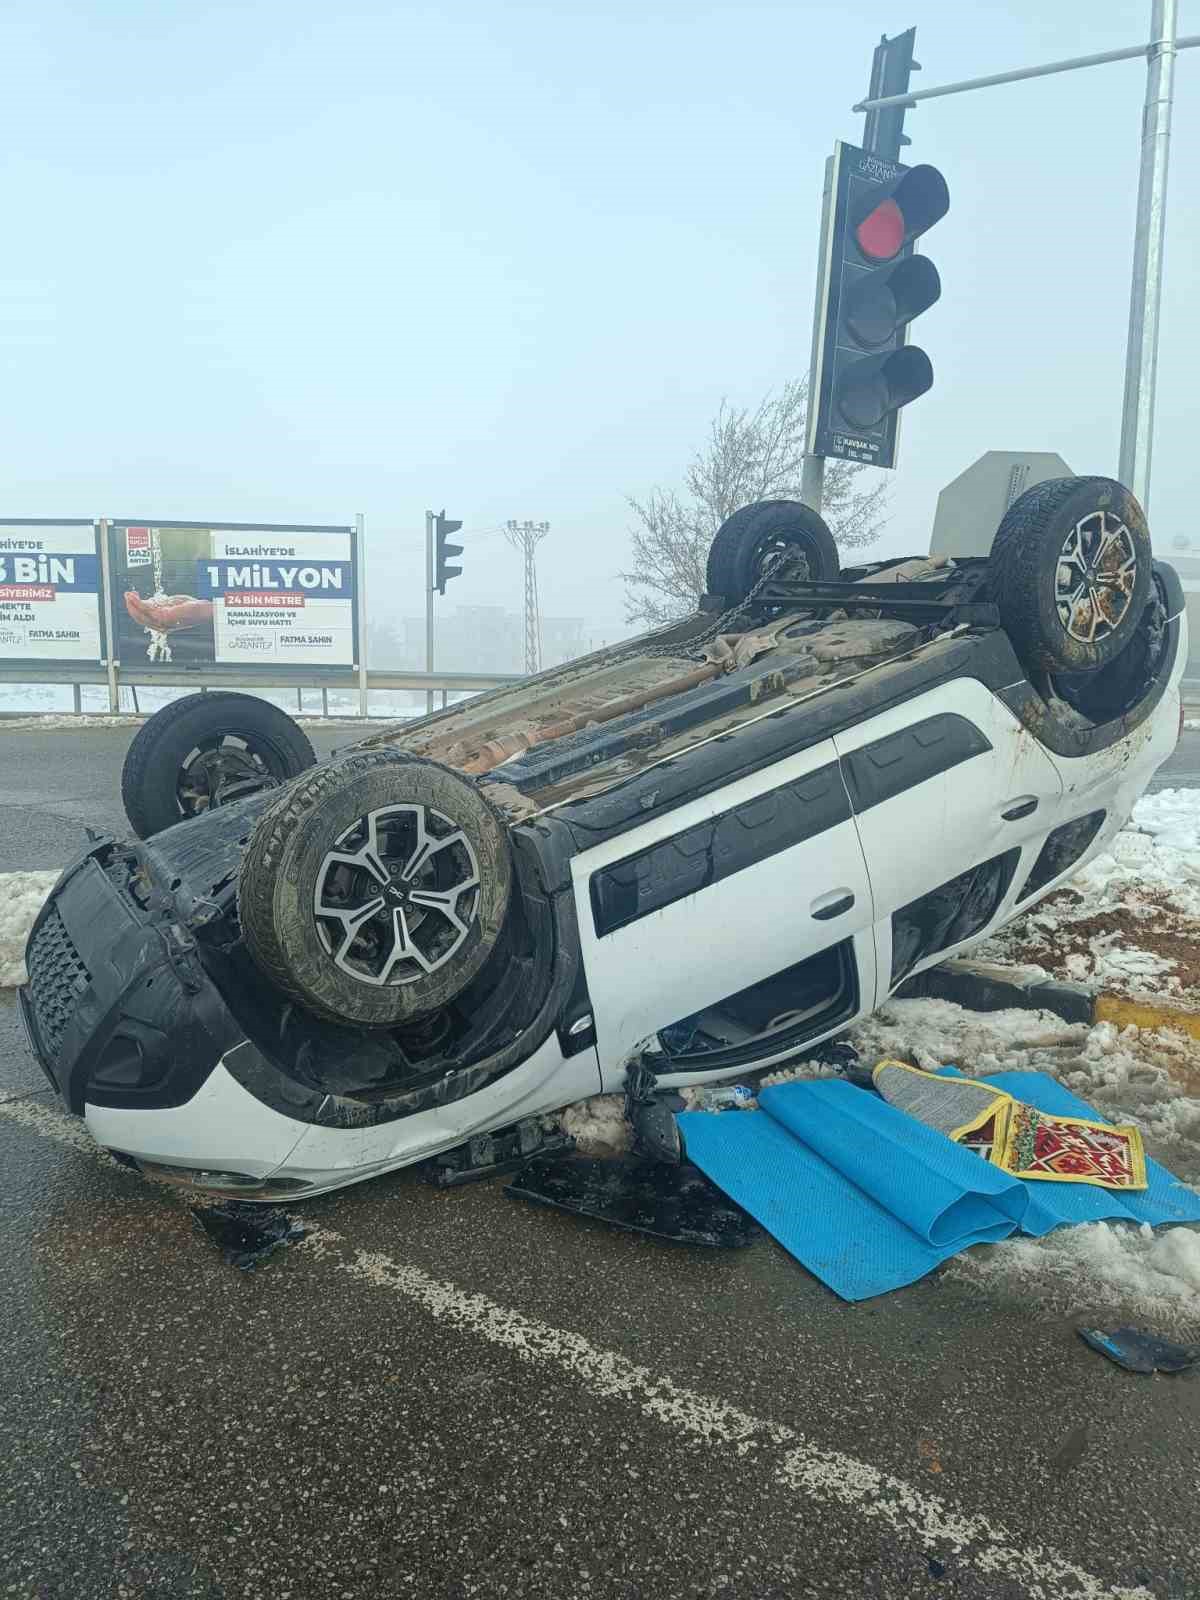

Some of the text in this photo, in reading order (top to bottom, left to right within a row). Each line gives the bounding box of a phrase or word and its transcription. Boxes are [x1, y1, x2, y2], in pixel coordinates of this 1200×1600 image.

[225, 545, 296, 556] İSLAHİYE'DE
[14, 554, 75, 584] BİN
[208, 564, 342, 589] 1 MİLYON
[227, 594, 302, 605] 24 BİN METRE
[227, 609, 285, 618] KANALİZASYON
[280, 635, 306, 644] FATMA
